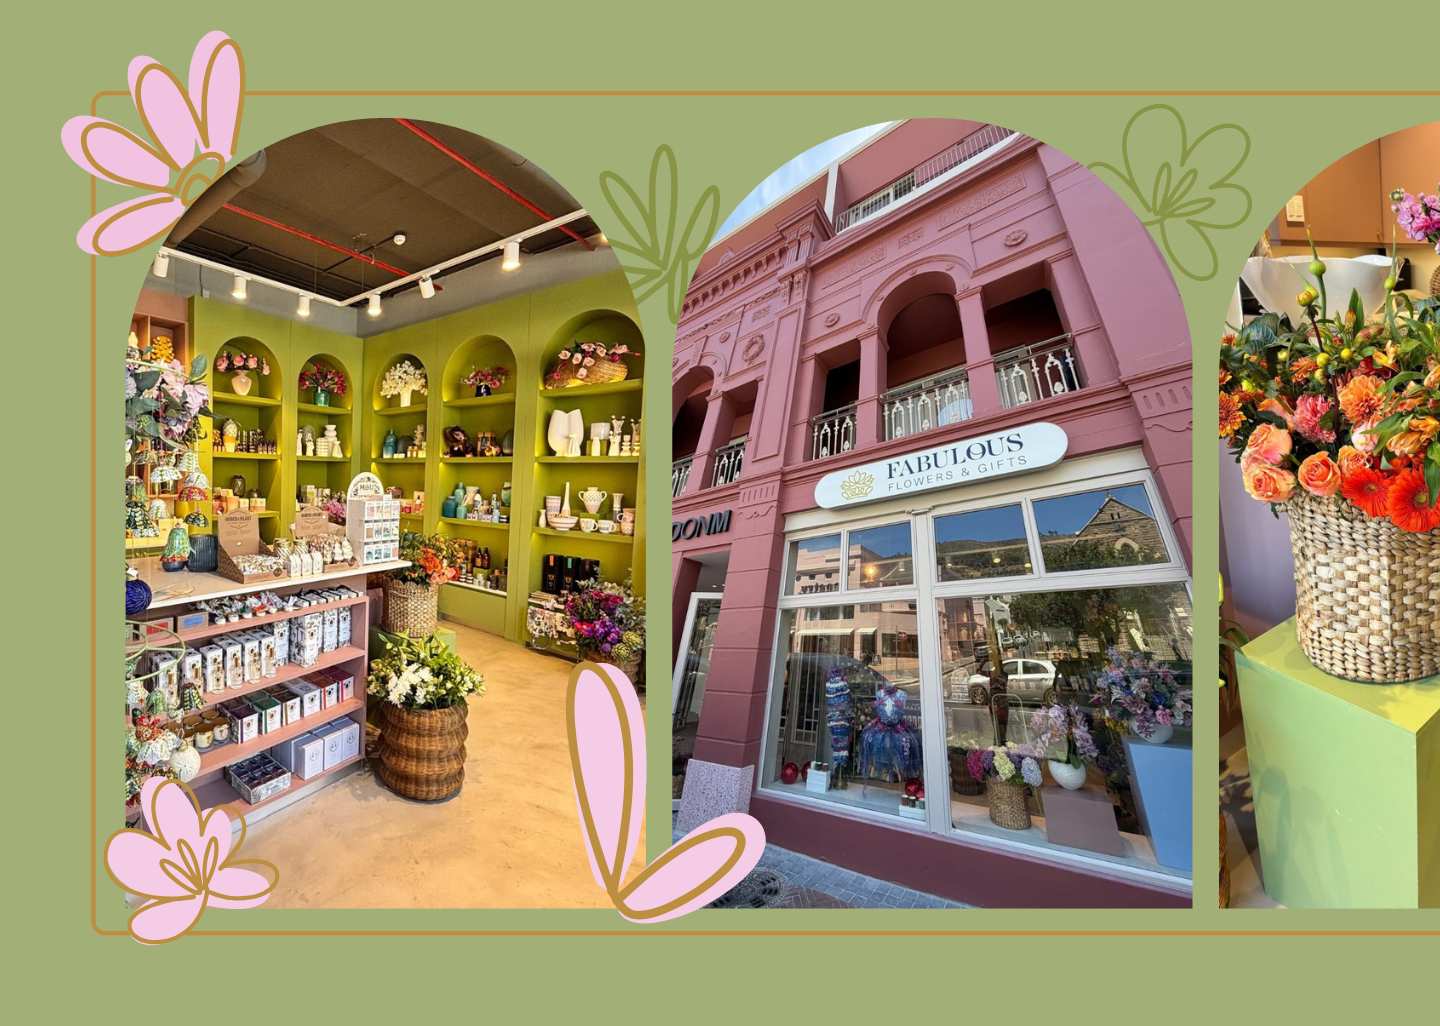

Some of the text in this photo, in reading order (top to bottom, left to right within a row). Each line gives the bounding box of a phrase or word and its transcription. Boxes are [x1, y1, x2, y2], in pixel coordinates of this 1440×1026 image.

[887, 432, 1024, 479] FABULOUS
[887, 455, 1028, 492] FLOWERS & GIFTS
